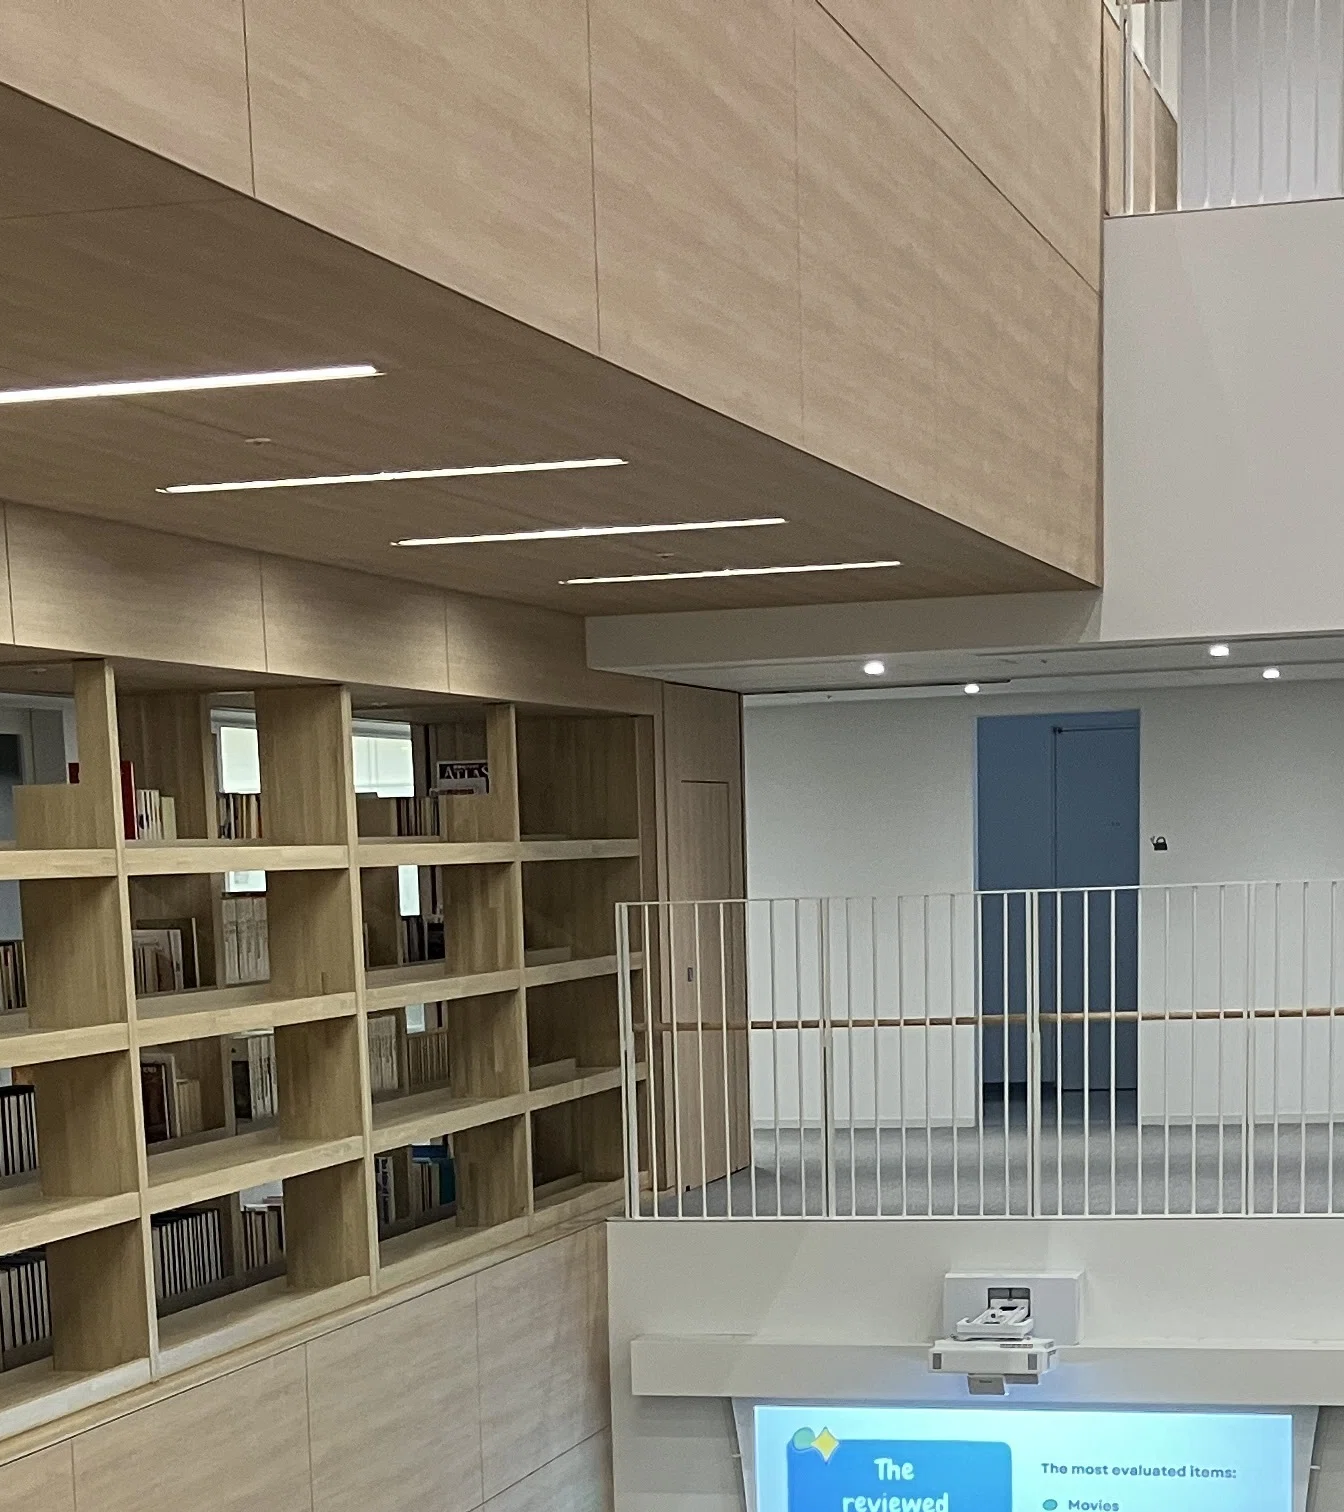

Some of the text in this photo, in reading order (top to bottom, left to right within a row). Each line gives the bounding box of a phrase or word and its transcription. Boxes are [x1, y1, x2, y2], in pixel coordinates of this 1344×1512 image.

[873, 1457, 915, 1481] The
[1041, 1462, 1237, 1479] The most evaluated items:
[1067, 1499, 1120, 1512] Movies
